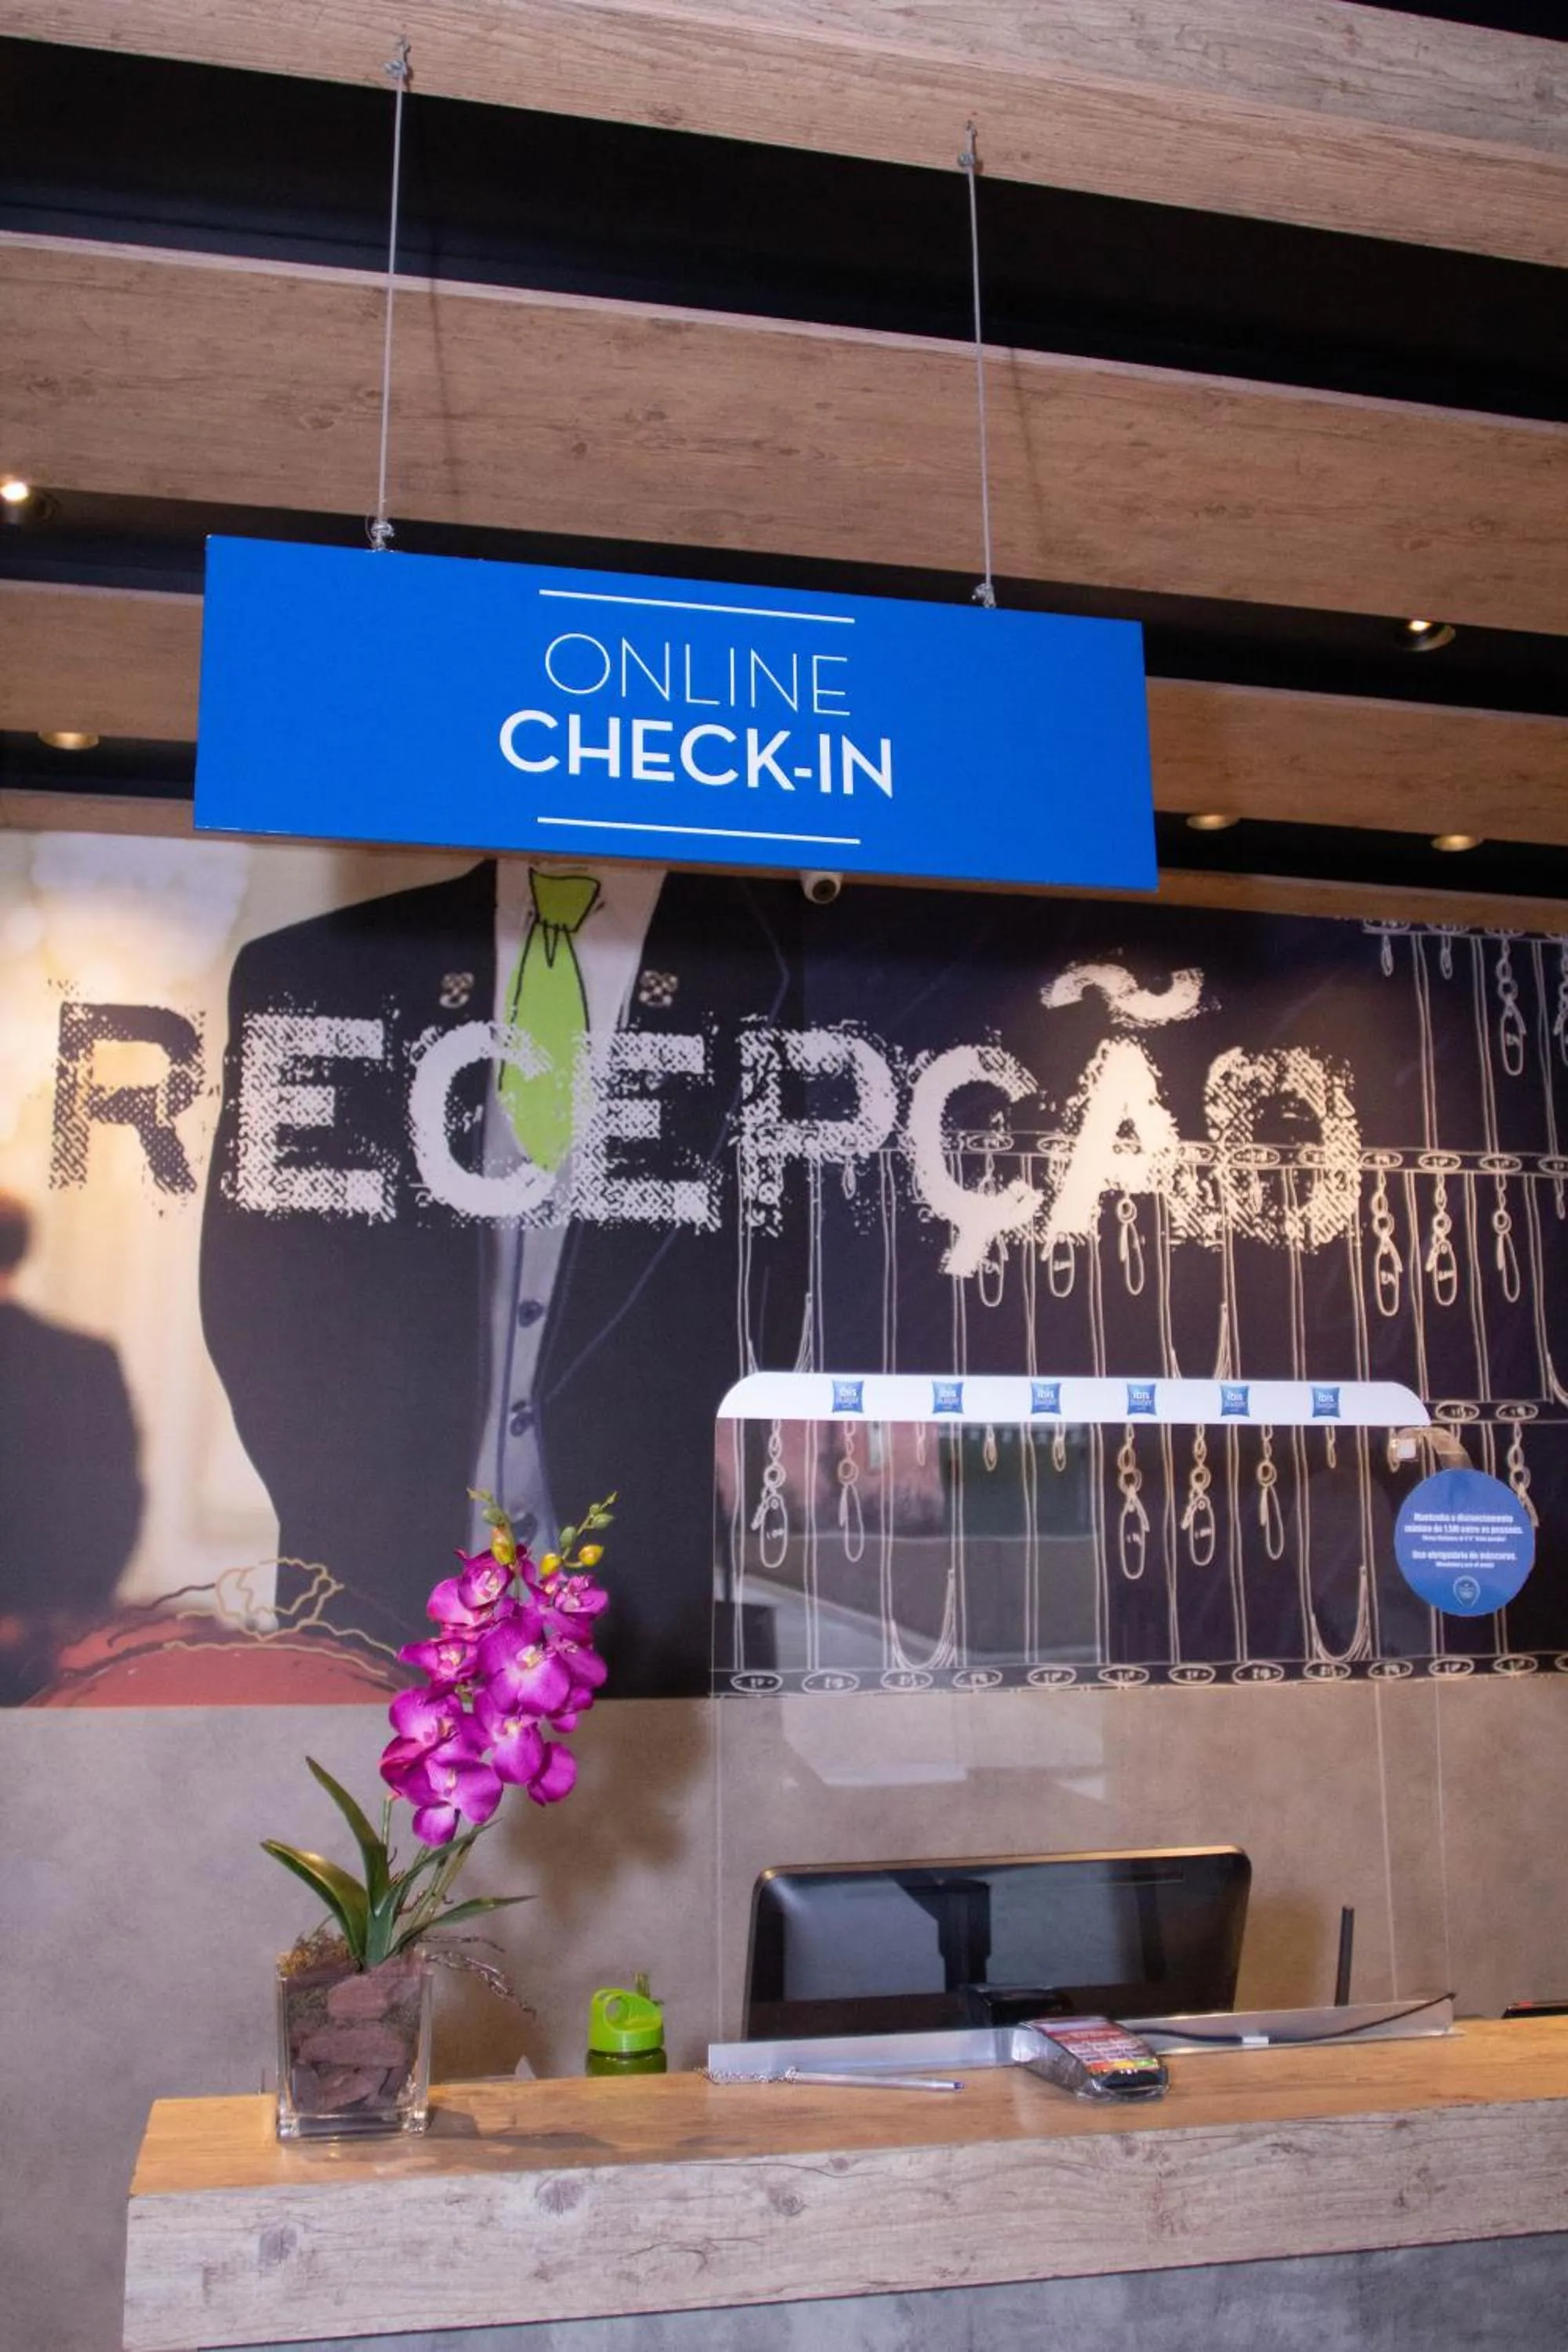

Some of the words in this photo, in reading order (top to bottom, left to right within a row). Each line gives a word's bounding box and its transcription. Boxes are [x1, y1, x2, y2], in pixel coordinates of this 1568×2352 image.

[545, 633, 851, 716] ONLINE
[499, 710, 893, 799] CHECK-IN
[49, 960, 1363, 1279] RECEPÇÃO
